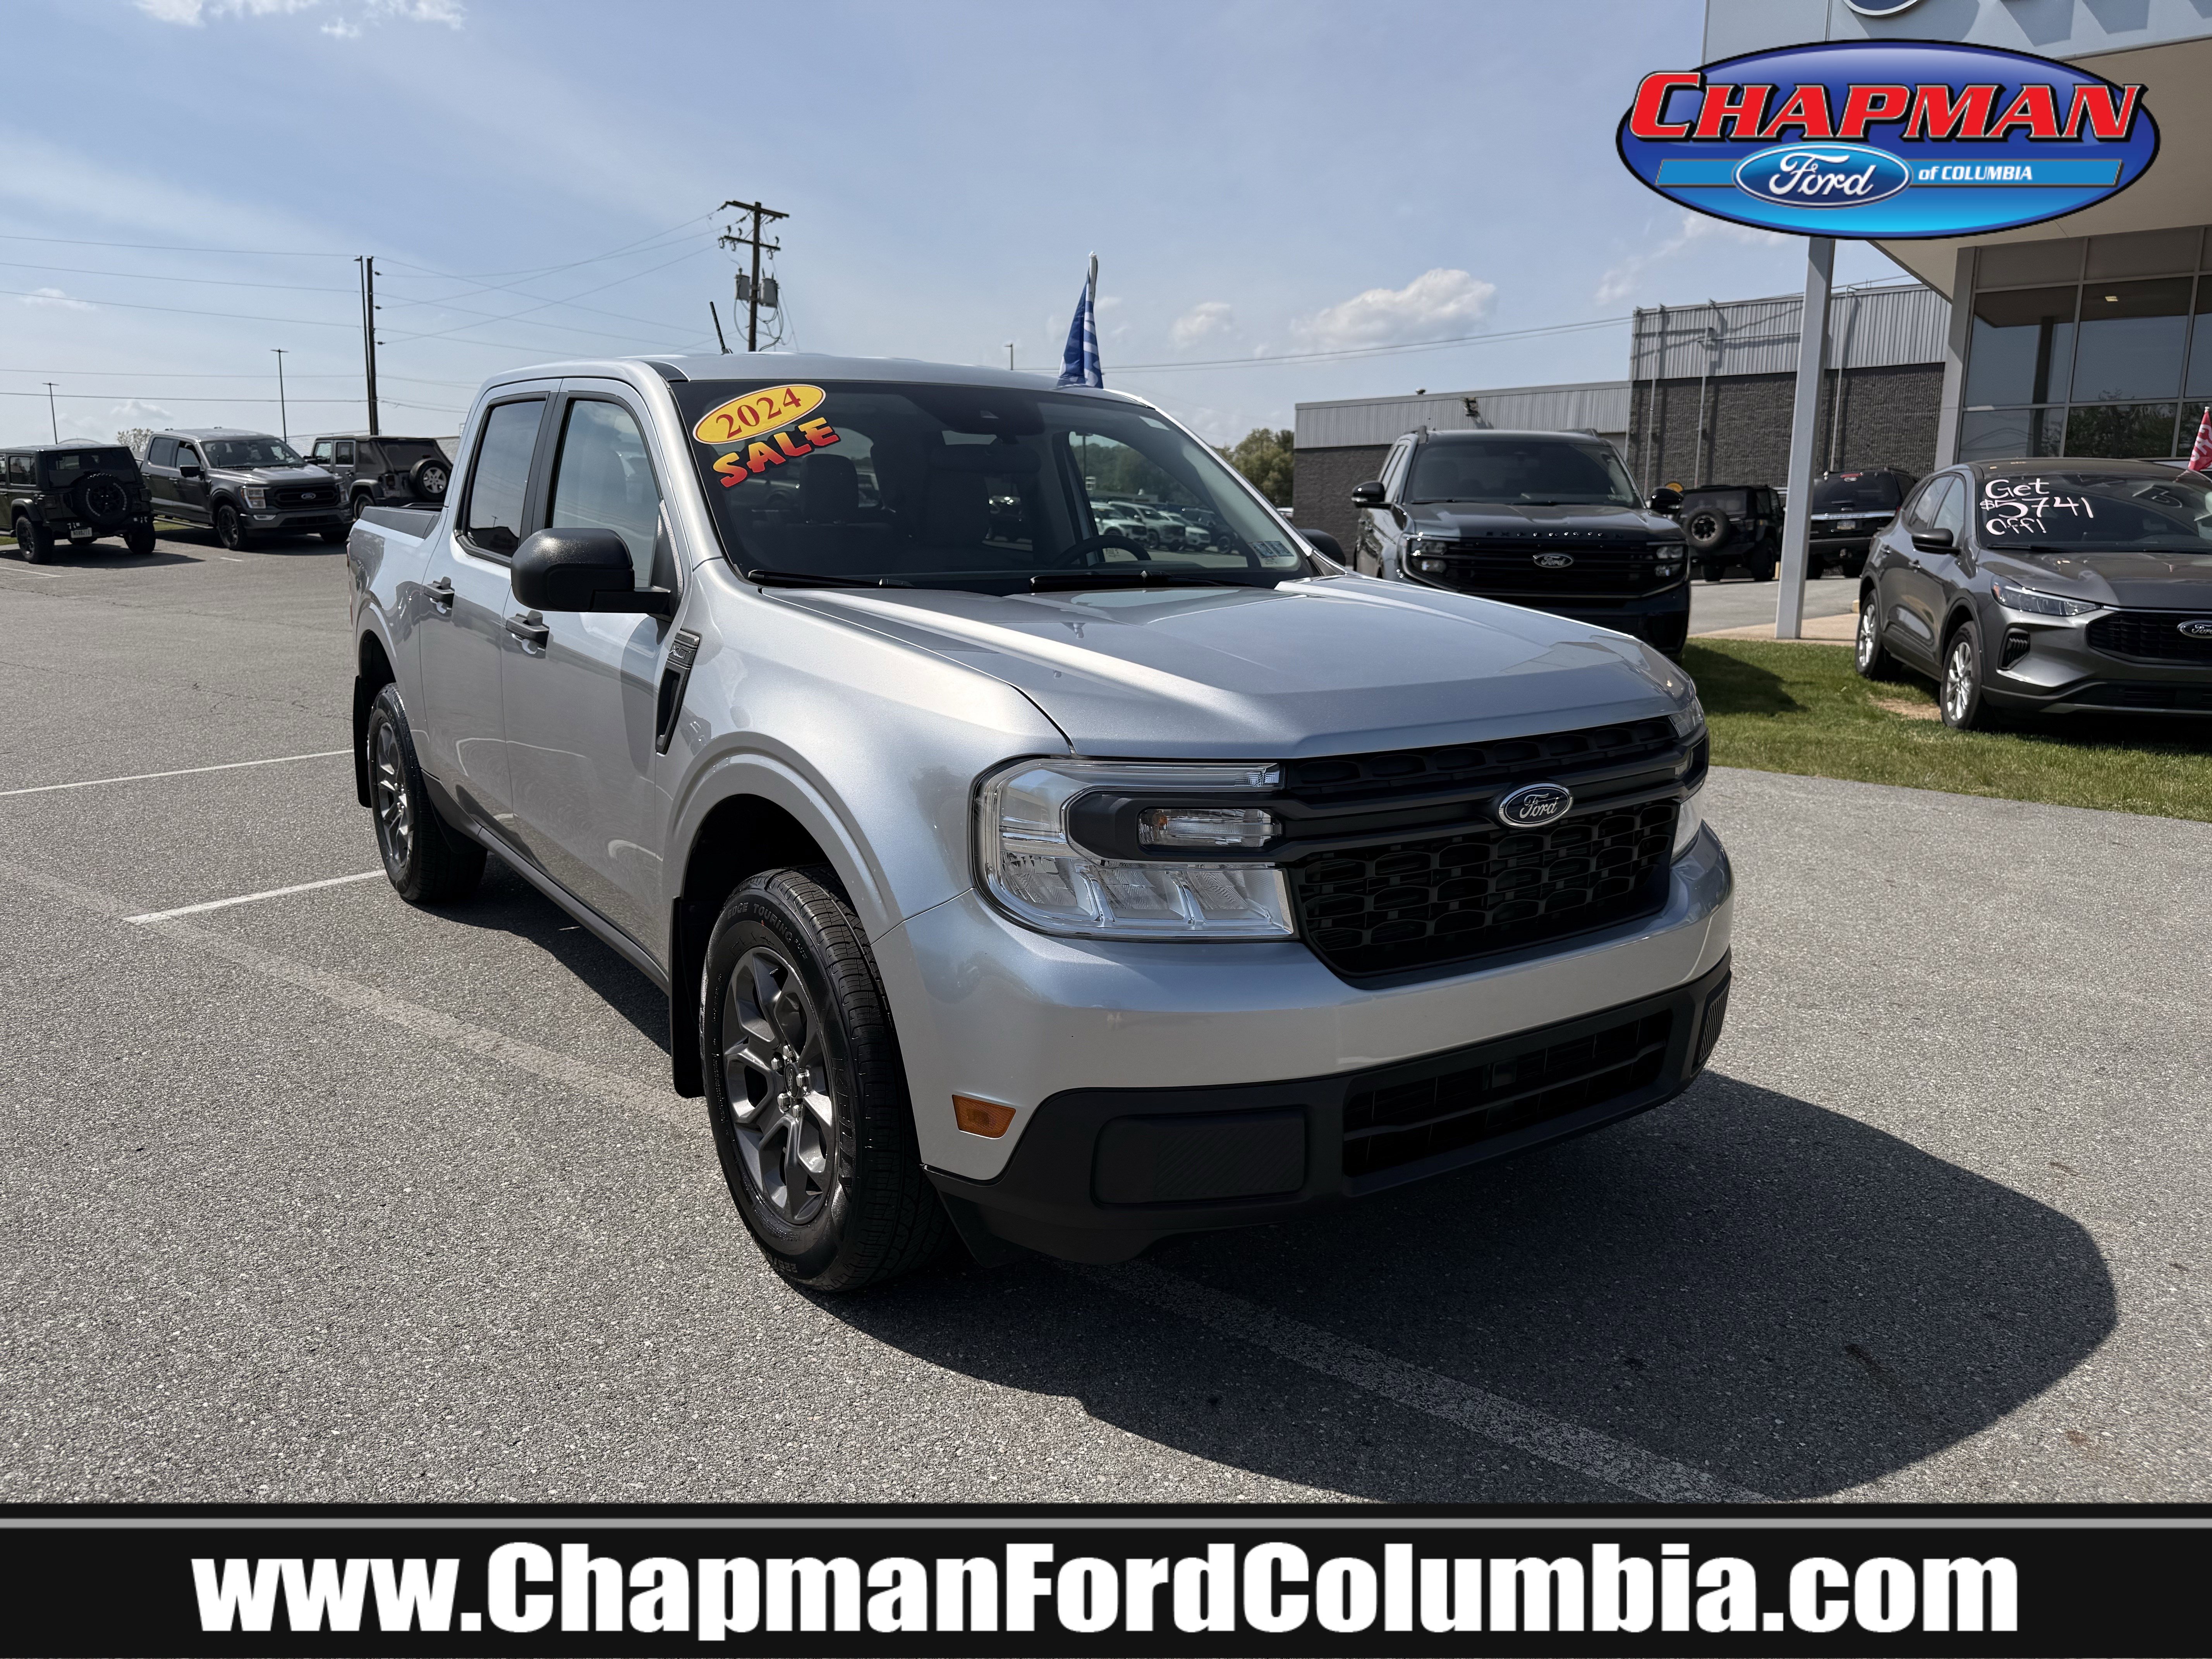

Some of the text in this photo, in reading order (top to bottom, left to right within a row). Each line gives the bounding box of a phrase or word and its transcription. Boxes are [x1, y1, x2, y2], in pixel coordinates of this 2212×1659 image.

[716, 388, 802, 439] 2024
[713, 417, 840, 488] SALE
[1985, 478, 2050, 499] Get
[1979, 497, 2094, 518] $5741
[1986, 517, 2047, 535] Off!
[669, 645, 690, 659] XLT
[1519, 793, 1558, 819] Ford
[728, 902, 793, 943] EDGE TOURING
